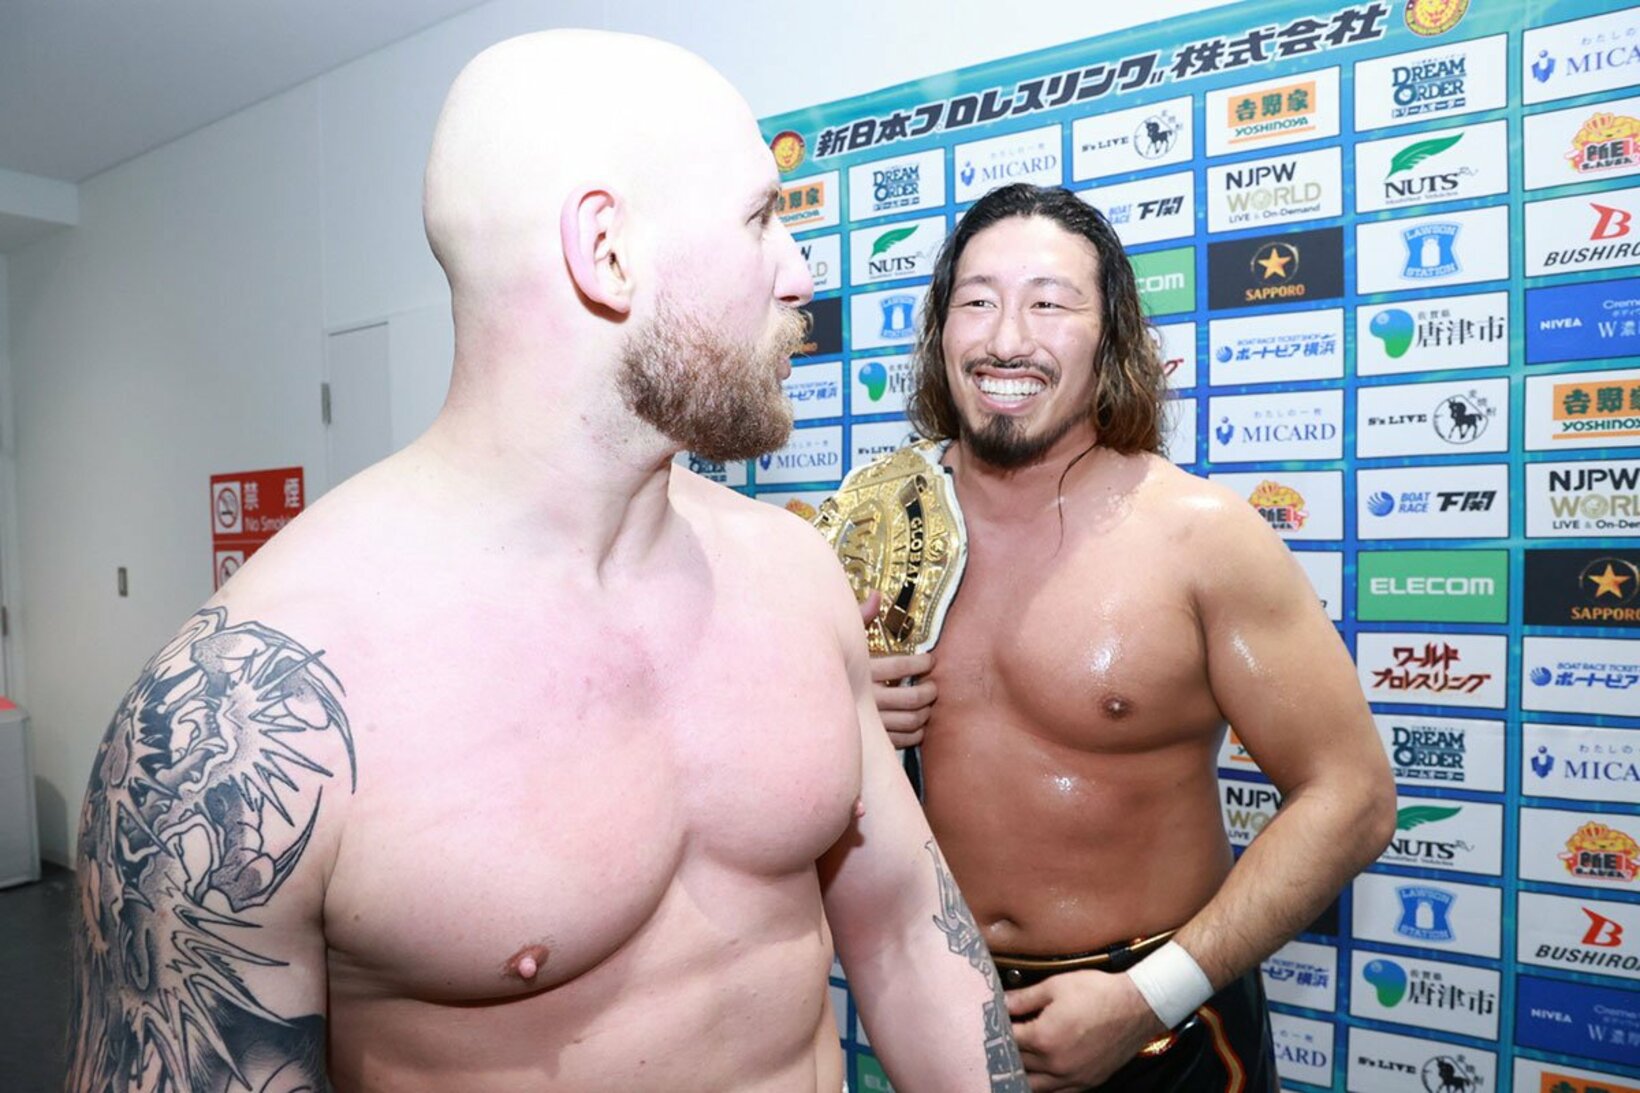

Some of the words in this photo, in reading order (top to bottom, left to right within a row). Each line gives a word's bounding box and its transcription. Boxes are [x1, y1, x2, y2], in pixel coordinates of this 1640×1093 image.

[1392, 57, 1465, 86] DREAM
[1393, 80, 1465, 106] ORDER
[1235, 89, 1308, 122] 吉野家
[1236, 117, 1309, 137] YOSHINOYA
[1099, 137, 1129, 149] LIVE
[873, 165, 920, 186] DREAM
[982, 155, 1058, 181] MICARD
[1226, 162, 1296, 190] NJPW
[874, 182, 920, 202] ORDER
[1385, 173, 1459, 198] NUTS
[1138, 195, 1185, 220] 下関
[1227, 183, 1321, 213] WORLD
[869, 256, 916, 275] NUTS
[1245, 284, 1305, 301] SAPPORO
[1417, 316, 1504, 347] 唐津市
[1540, 318, 1583, 330] NIVEA
[1389, 414, 1427, 425] LIVE
[1242, 423, 1336, 443] MICARD
[776, 452, 838, 469] MICARD
[1549, 468, 1640, 491] NJPW
[1401, 492, 1431, 502] BOAT
[1436, 491, 1497, 512] 下関
[1398, 503, 1428, 513] RACE
[1553, 520, 1580, 530] LIVE
[1371, 577, 1494, 595] ELECOM
[1393, 642, 1461, 671] ワールド
[1371, 668, 1492, 693] プロレスリング
[1392, 727, 1465, 749] DREAM
[1393, 745, 1465, 768] ORDER
[1409, 981, 1496, 1015] 唐津市
[1531, 1008, 1572, 1023] NIVEA
[1379, 1059, 1416, 1074] LIVE
